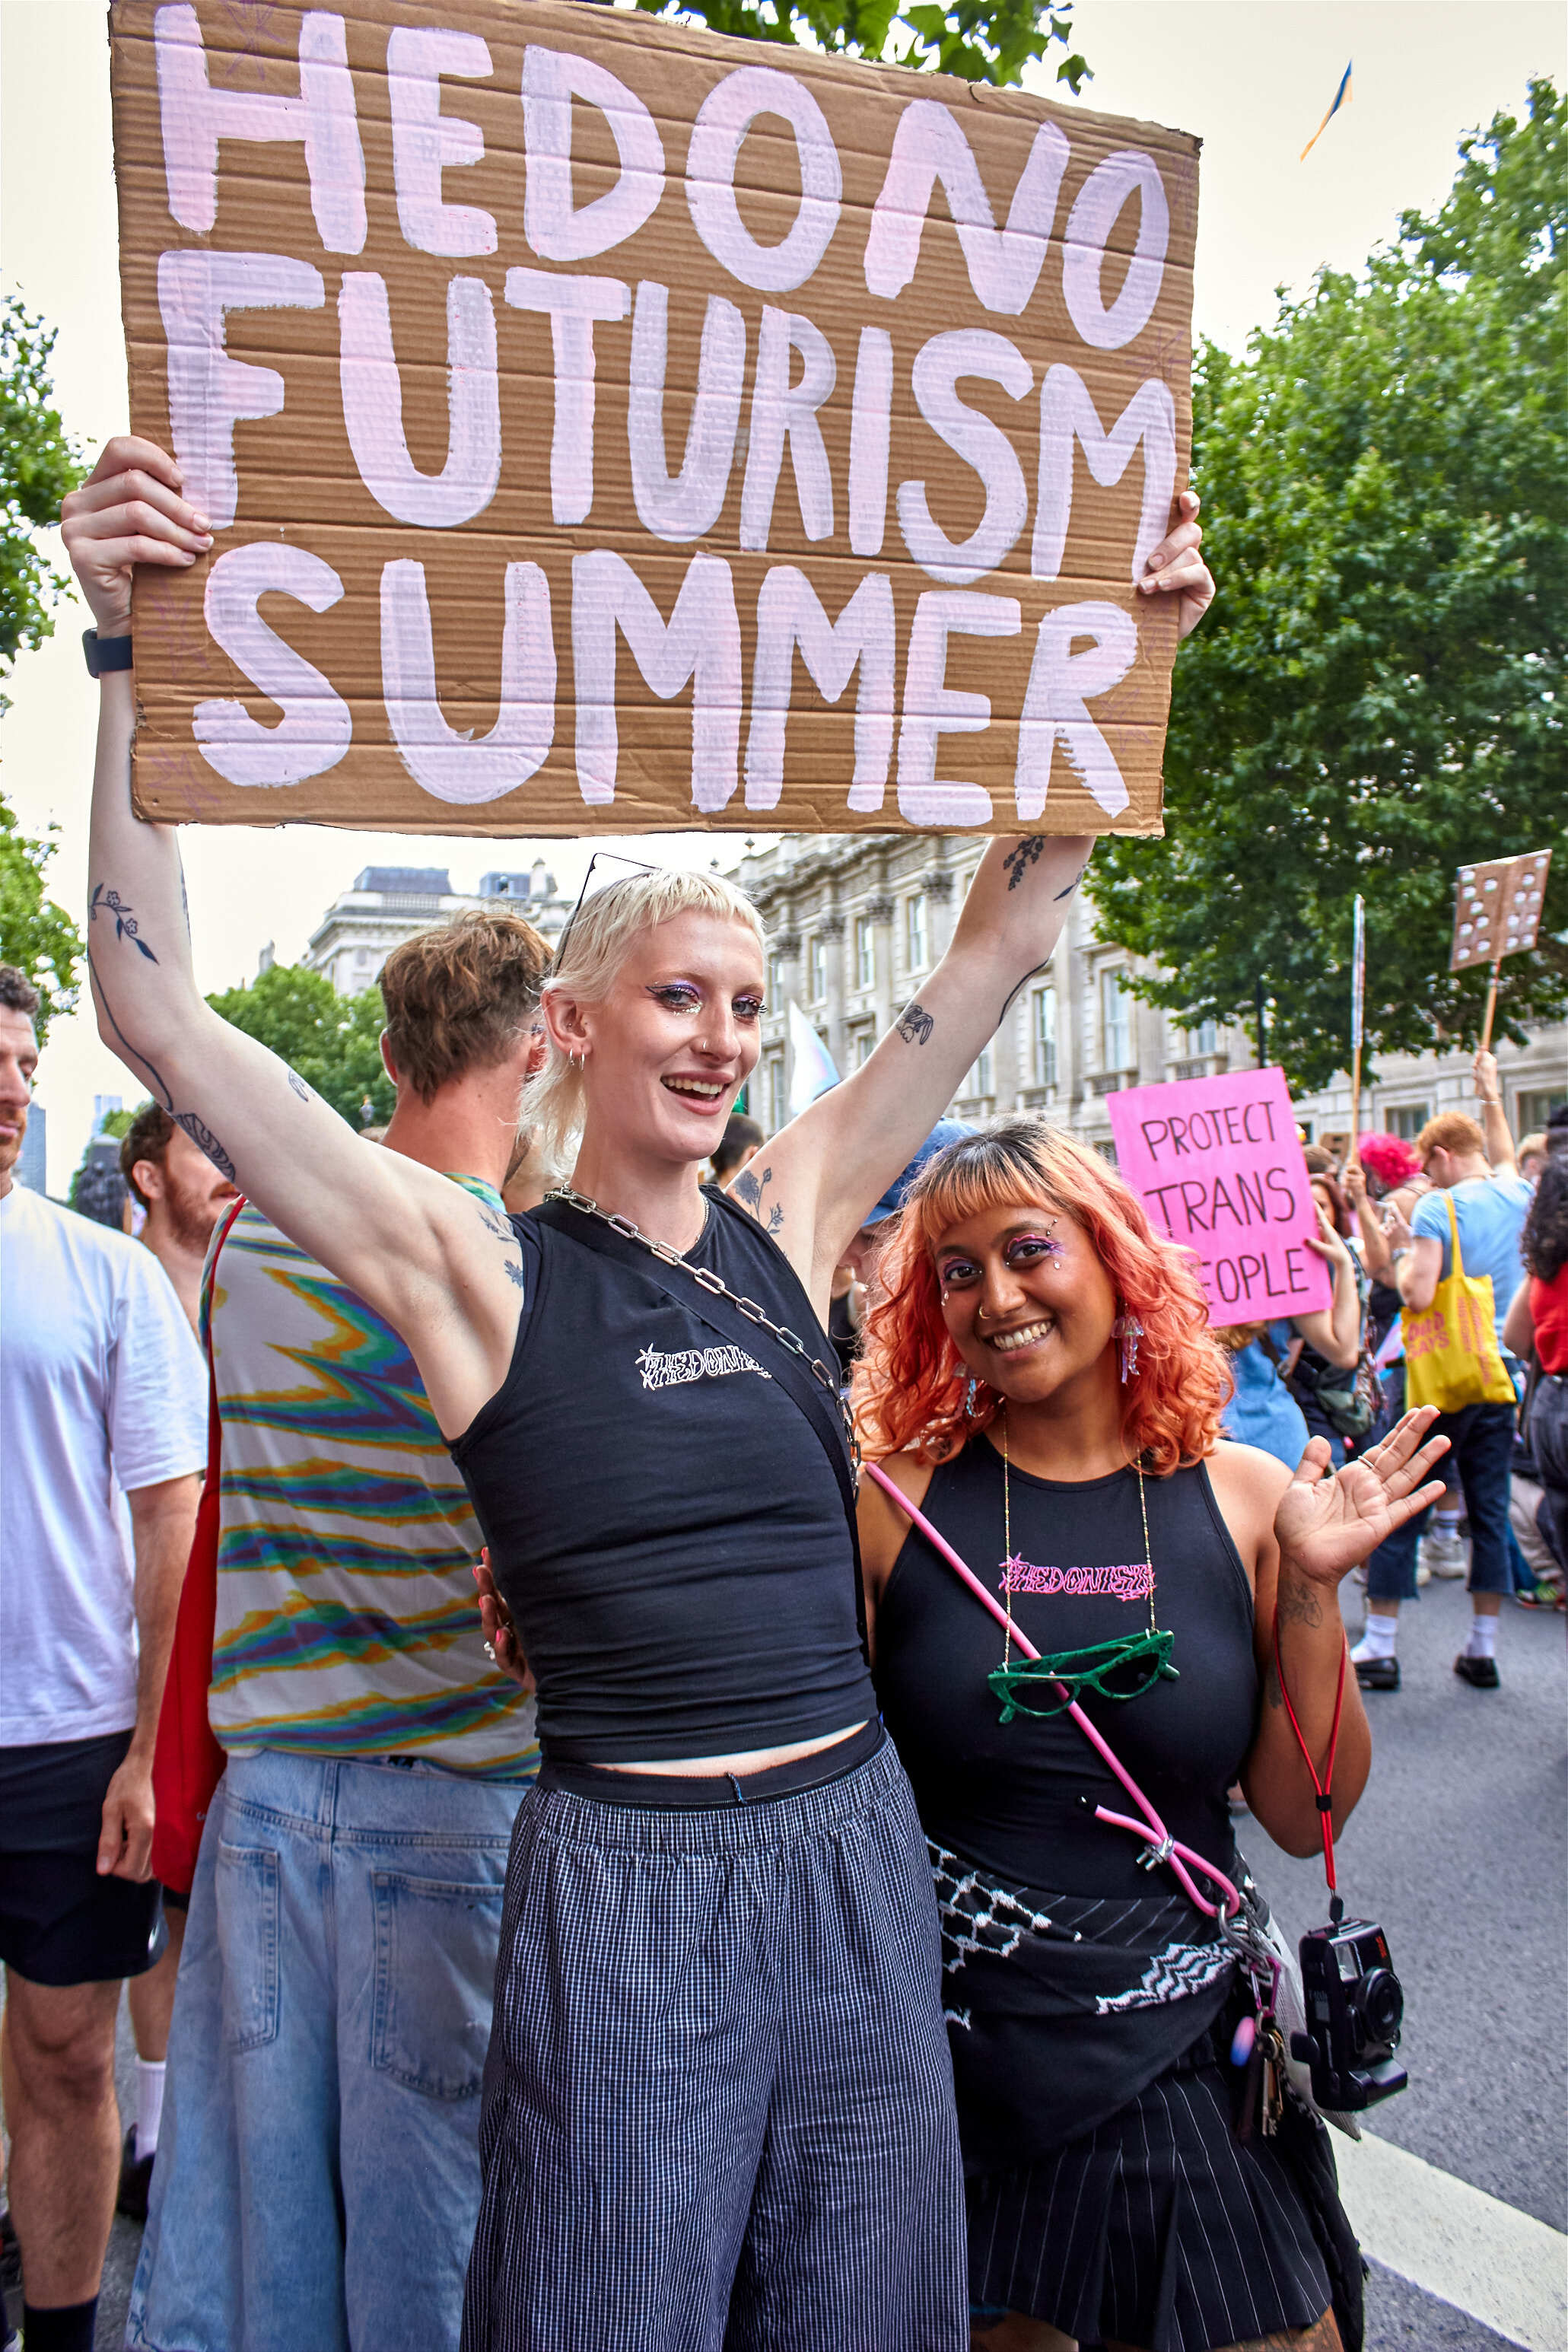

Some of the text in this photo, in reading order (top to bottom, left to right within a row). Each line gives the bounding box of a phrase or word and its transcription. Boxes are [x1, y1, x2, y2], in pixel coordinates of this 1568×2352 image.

[157, 249, 1178, 586] FUTURISM
[192, 540, 1138, 829] SUMMER
[1140, 1100, 1276, 1161] PROTECT
[1143, 1167, 1296, 1237] TRANS
[1190, 1248, 1309, 1306] EOPLE
[998, 1552, 1157, 1601] HEDONIST
